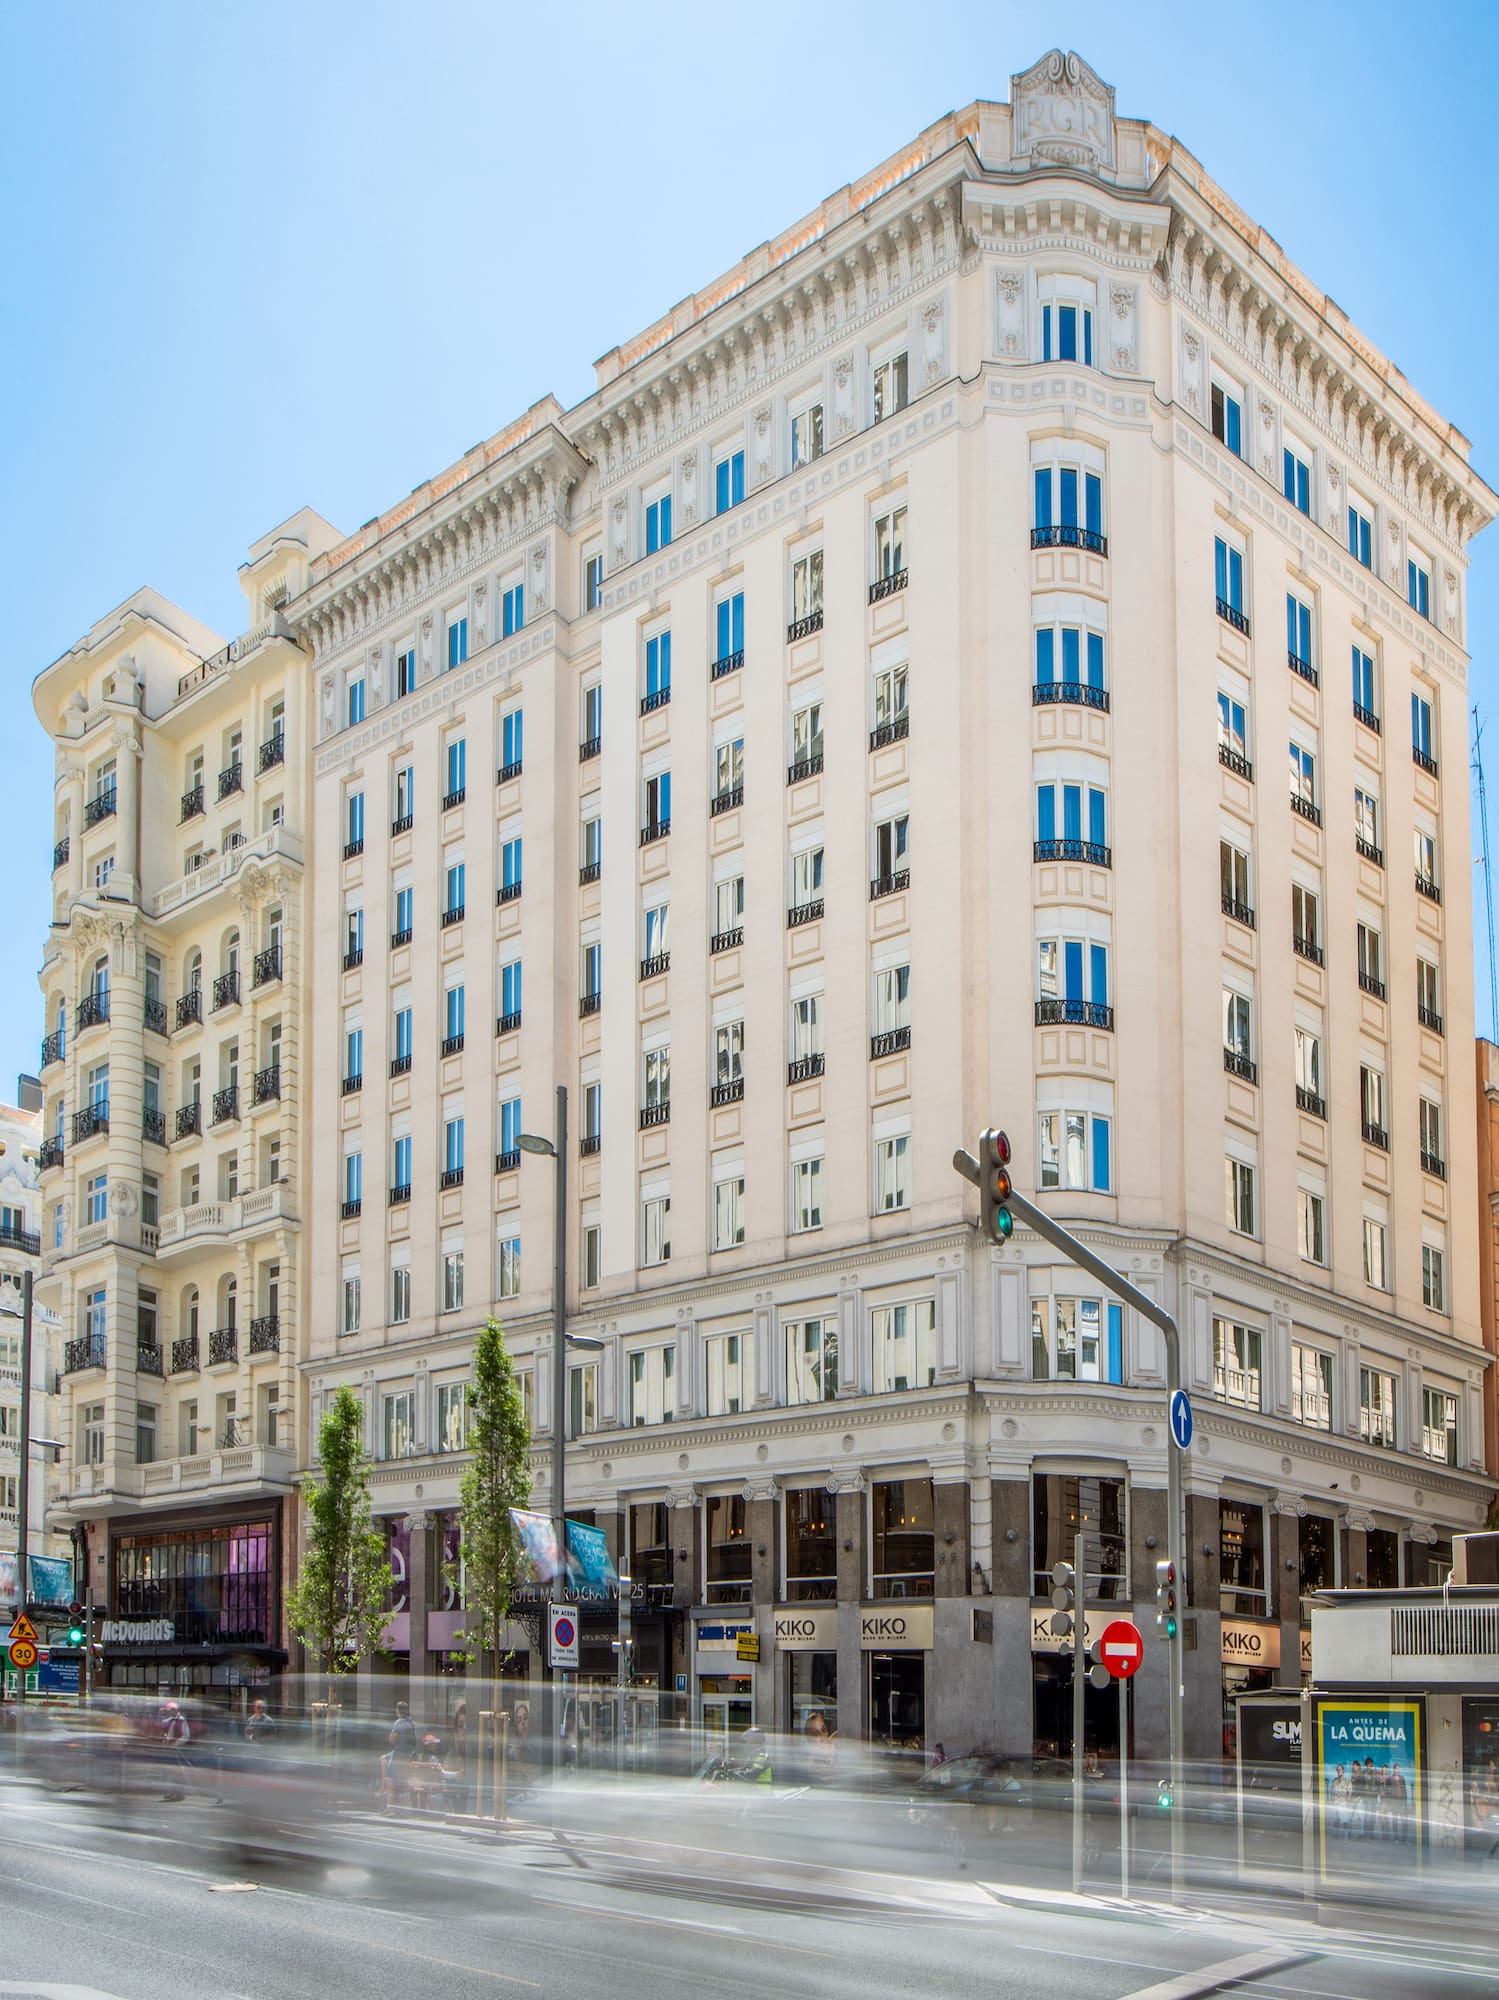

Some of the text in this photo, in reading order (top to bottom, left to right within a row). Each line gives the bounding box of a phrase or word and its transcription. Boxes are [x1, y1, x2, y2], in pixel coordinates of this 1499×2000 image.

[541, 1586, 579, 1602] MARID
[631, 1584, 644, 1598] 25
[561, 1609, 576, 1617] ACERA
[101, 1619, 175, 1641] McDonald's
[775, 1620, 816, 1636] KIKO
[862, 1618, 906, 1634] KIKO
[1223, 1632, 1261, 1651] KIKO
[15, 1648, 32, 1659] 30
[1331, 1726, 1407, 1741] LA QUEMA
